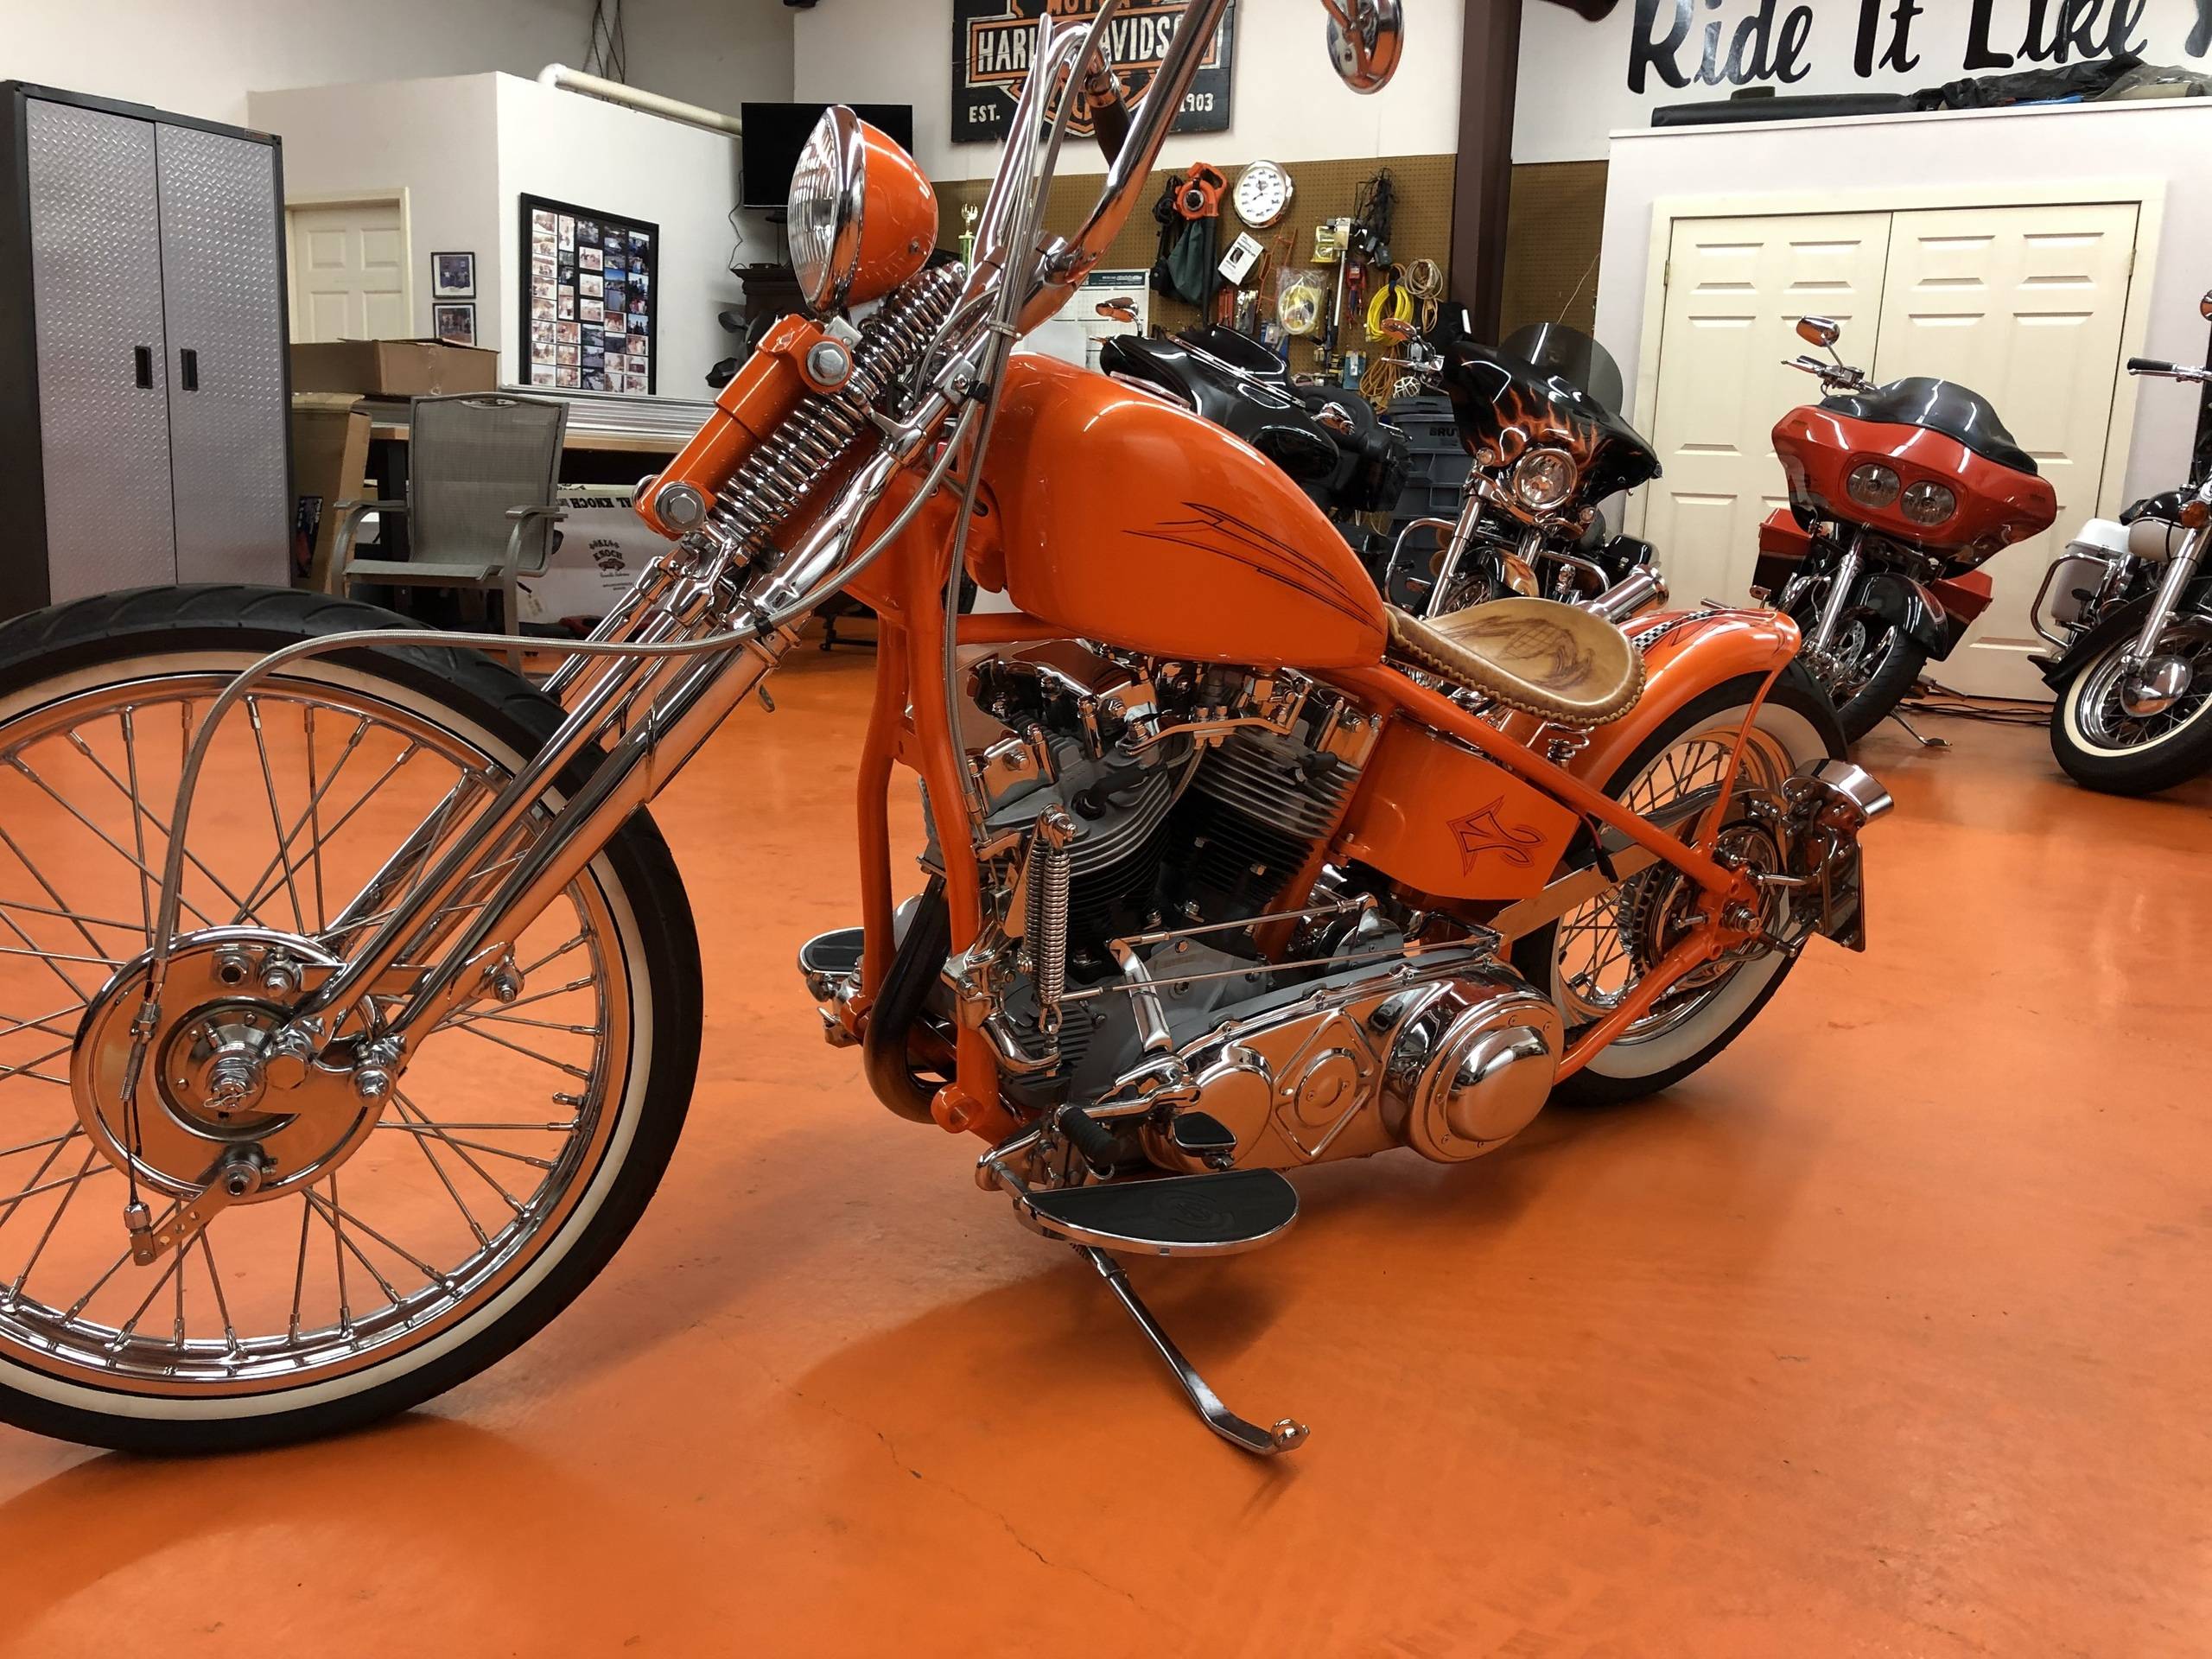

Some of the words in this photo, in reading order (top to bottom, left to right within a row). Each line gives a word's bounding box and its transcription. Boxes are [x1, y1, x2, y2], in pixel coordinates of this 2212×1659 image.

[1628, 0, 1813, 94] Ride
[1853, 0, 1923, 78] It
[1962, 0, 2148, 69] Like
[969, 104, 1001, 123] EST.
[569, 497, 614, 509] KNOCH
